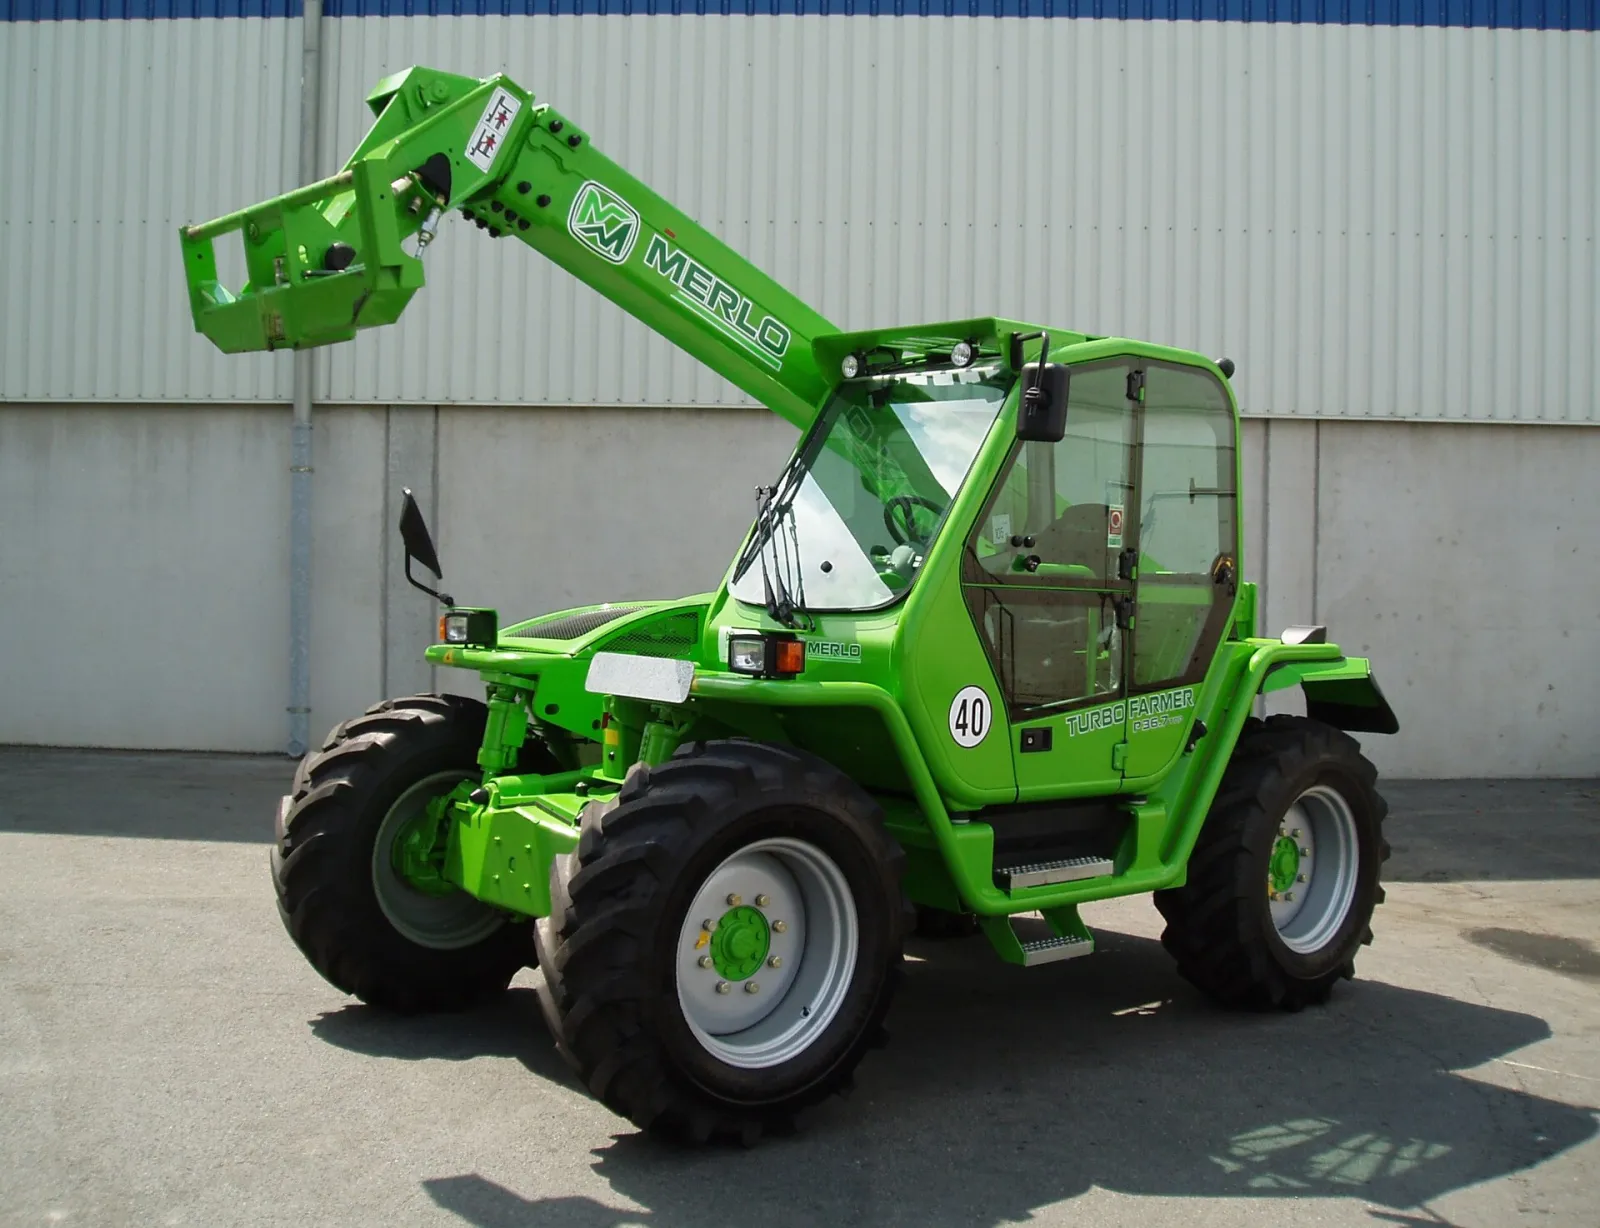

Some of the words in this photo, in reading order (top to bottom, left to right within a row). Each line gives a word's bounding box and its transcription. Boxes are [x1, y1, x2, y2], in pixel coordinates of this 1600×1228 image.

[643, 233, 791, 357] MERLO
[807, 640, 862, 658] MERLO
[955, 697, 985, 737] 40
[1066, 703, 1126, 737] TURBO
[1128, 687, 1194, 719] FARMER
